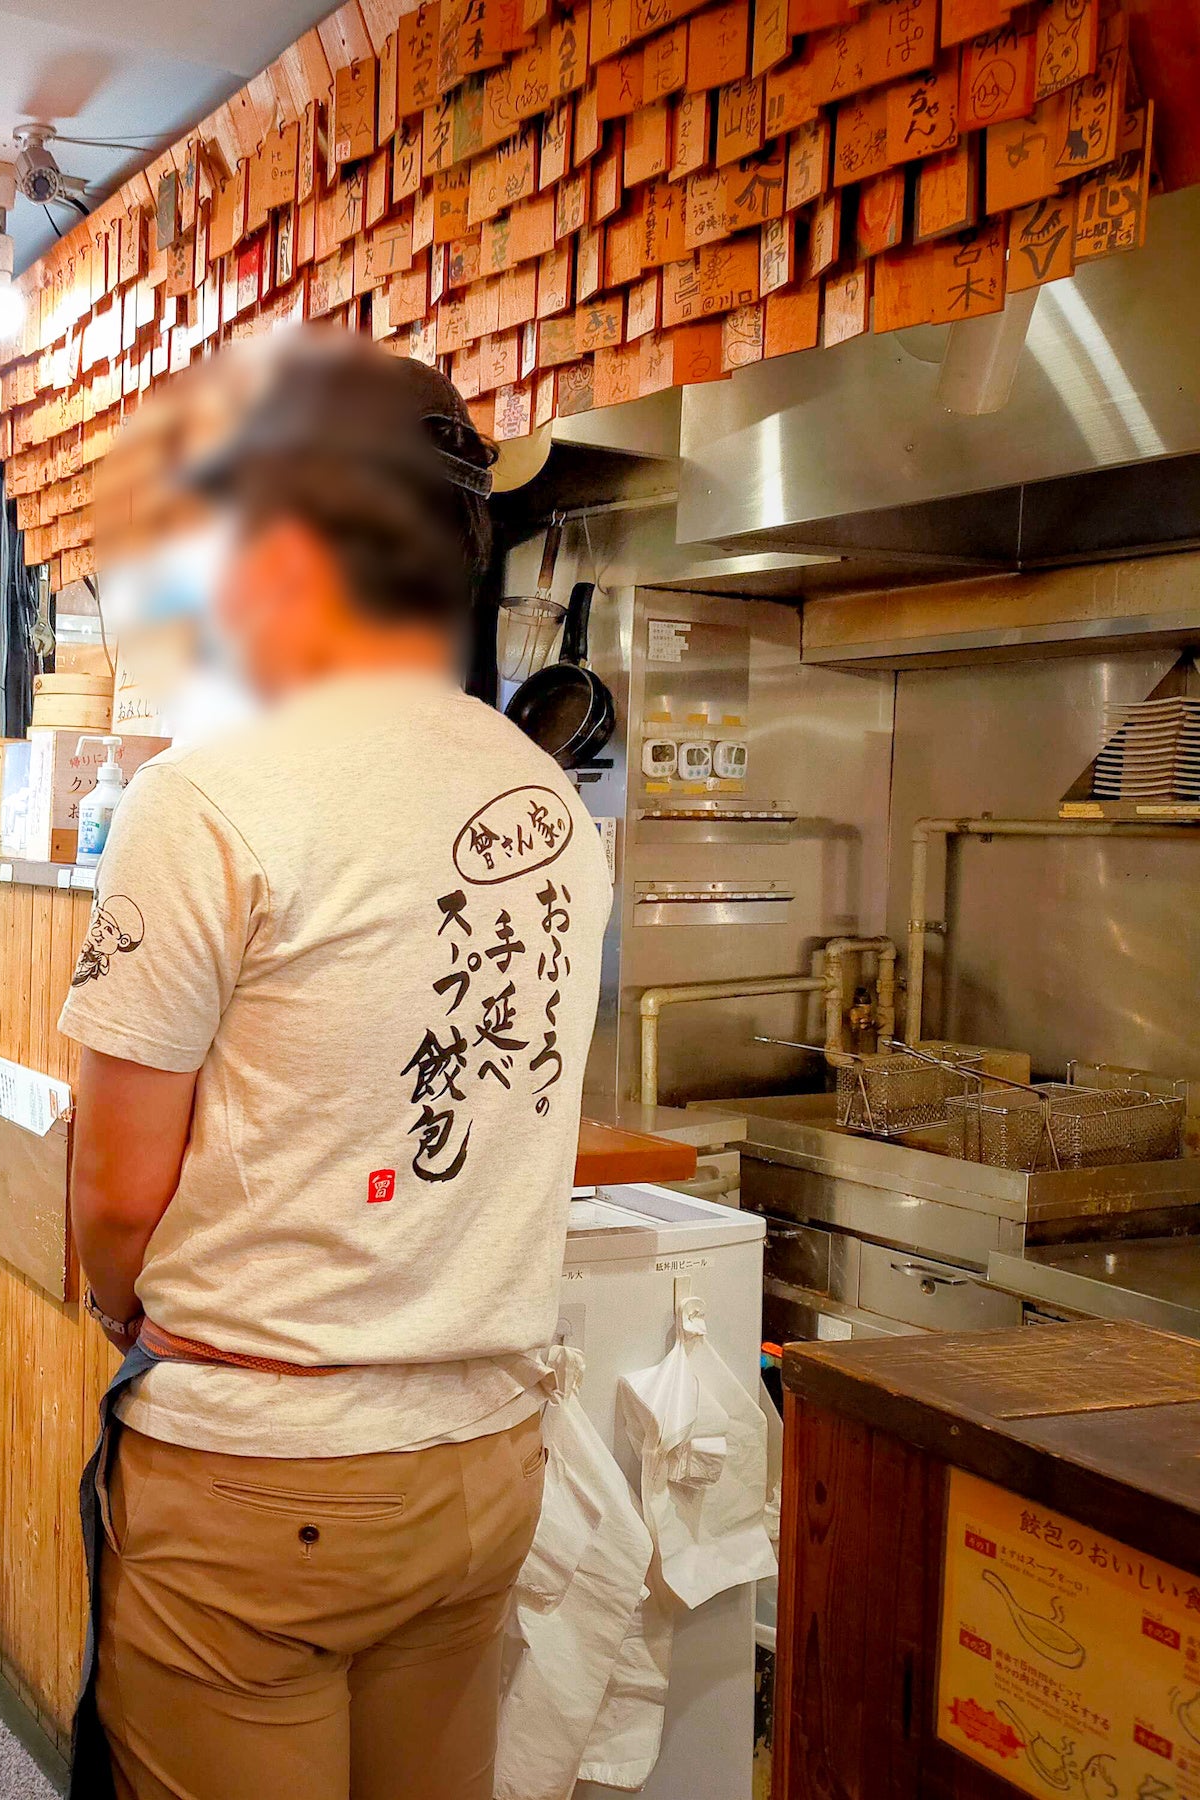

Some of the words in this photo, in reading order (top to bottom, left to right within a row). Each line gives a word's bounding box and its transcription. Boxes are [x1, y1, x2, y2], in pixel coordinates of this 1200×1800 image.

[70, 747, 125, 768] 帰りにず
[472, 909, 529, 1090] 手延べ
[529, 879, 572, 1117] おふくろの
